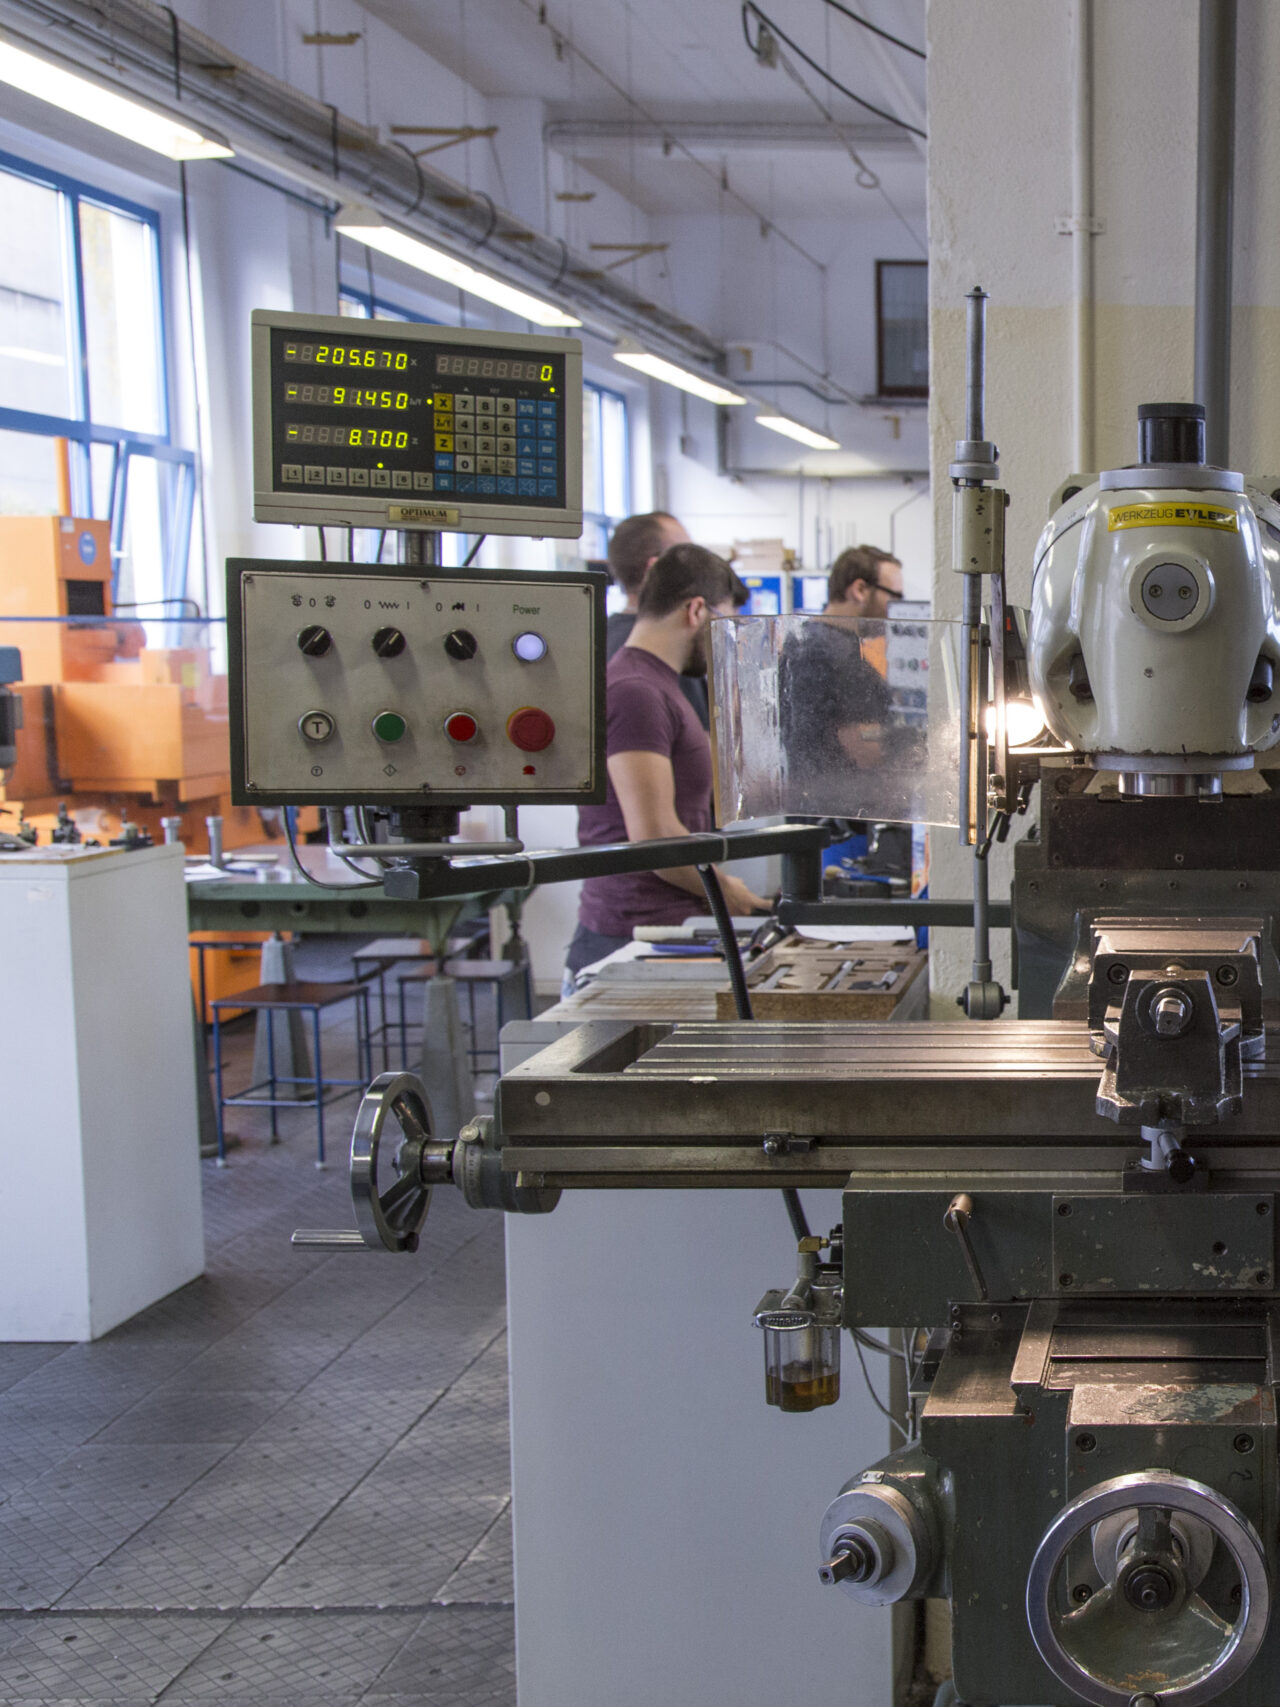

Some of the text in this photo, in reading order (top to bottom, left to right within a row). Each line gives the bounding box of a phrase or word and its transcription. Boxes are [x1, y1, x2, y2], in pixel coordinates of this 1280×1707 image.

[315, 346, 408, 370] 205.670
[540, 365, 553, 381] 0
[333, 387, 408, 410] 91.450
[439, 398, 448, 408] X
[460, 400, 468, 409] 7
[481, 402, 489, 411] 8
[502, 403, 510, 412] 9
[460, 420, 468, 429] 4
[482, 422, 490, 431] 5
[502, 423, 510, 432] 6
[349, 429, 408, 448] 8.700
[439, 439, 510, 452] Z 1 2 3
[461, 460, 469, 469] 0
[400, 508, 448, 518] OPTIMUM
[1114, 508, 1173, 524] WERKZEUG
[512, 604, 540, 615] Power
[311, 721, 323, 734] T
